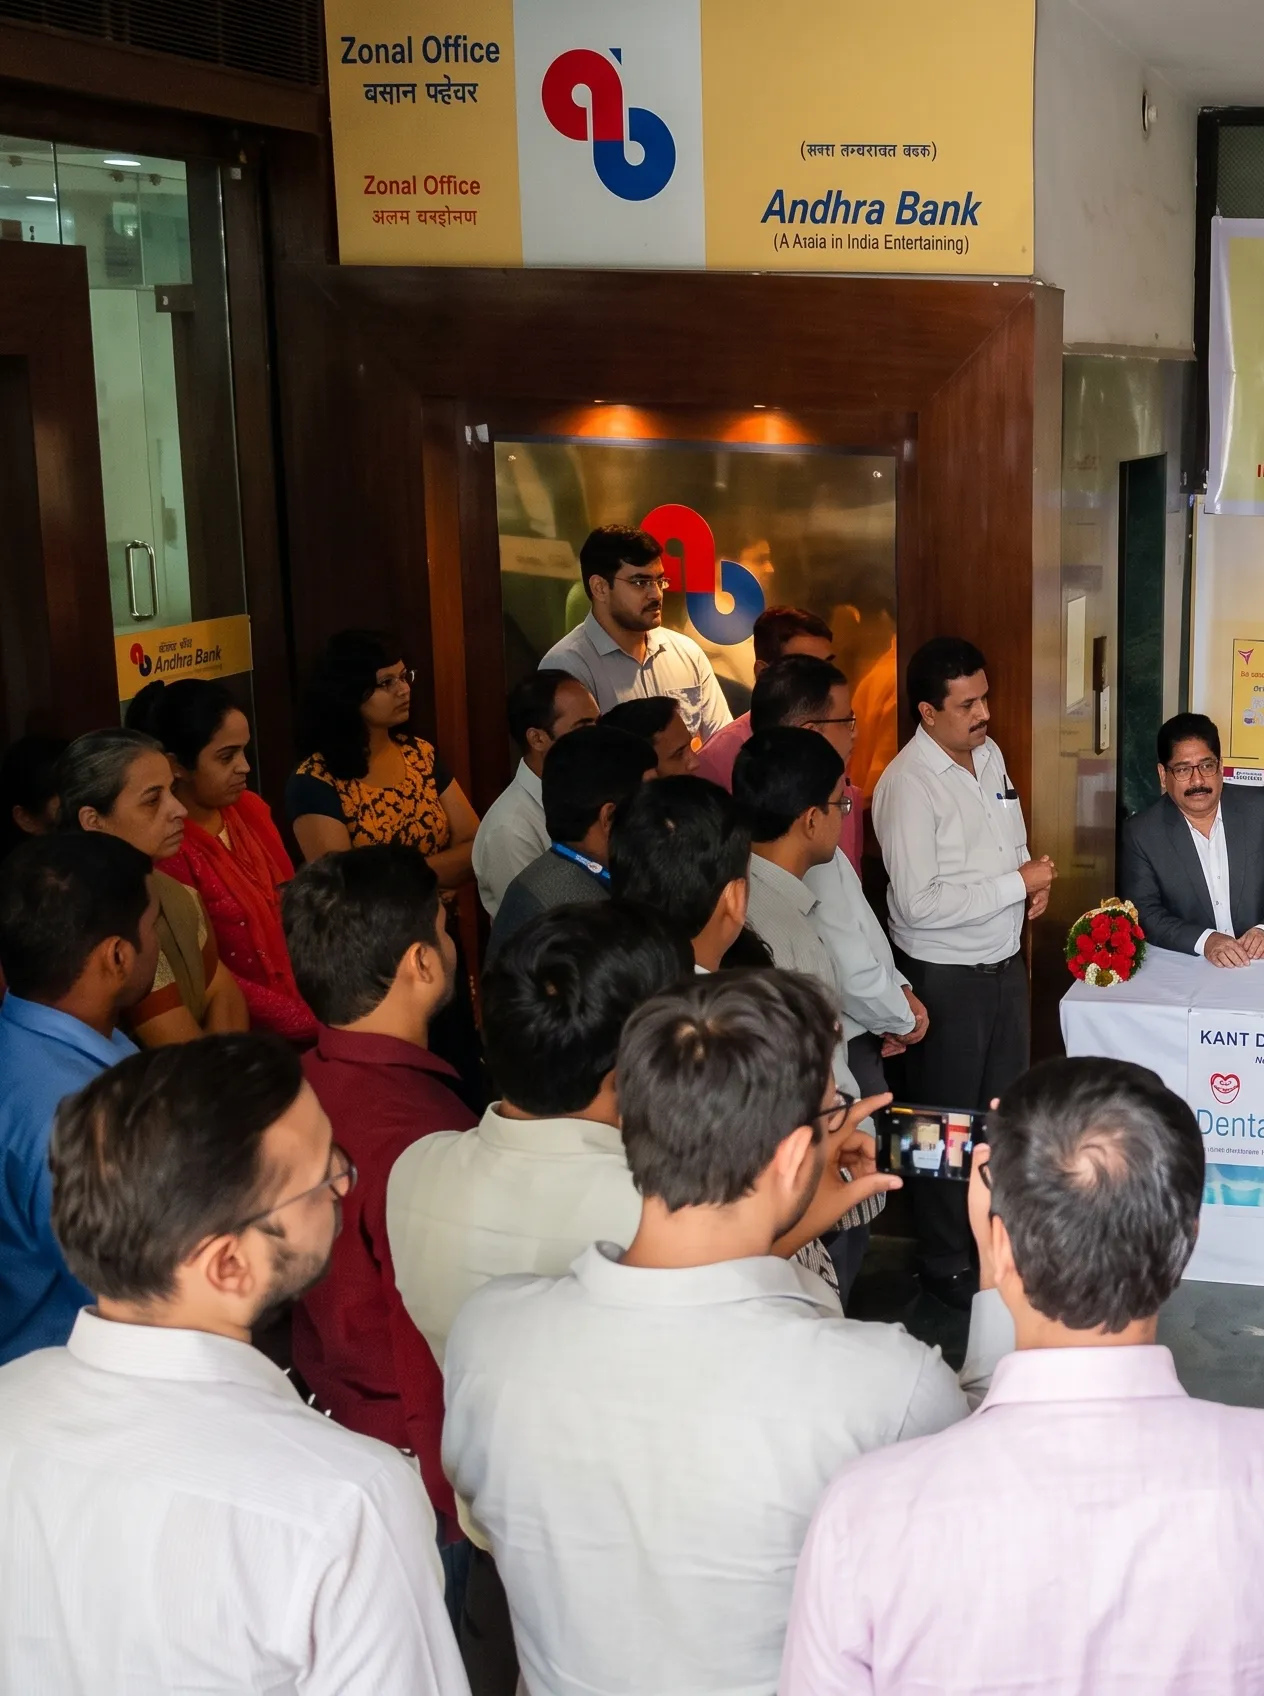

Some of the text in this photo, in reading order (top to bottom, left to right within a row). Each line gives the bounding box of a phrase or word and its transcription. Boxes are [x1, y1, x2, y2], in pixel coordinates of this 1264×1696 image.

[341, 35, 500, 64] Zonal Office
[363, 175, 480, 196] Zonal Office
[760, 189, 983, 227] Andhra Bank
[774, 233, 789, 253] (A
[831, 234, 843, 249] in
[848, 235, 880, 250] India
[884, 236, 969, 255] Entertaining)
[154, 652, 193, 674] Andhra
[195, 645, 222, 666] Bank
[1200, 1029, 1250, 1047] KANT
